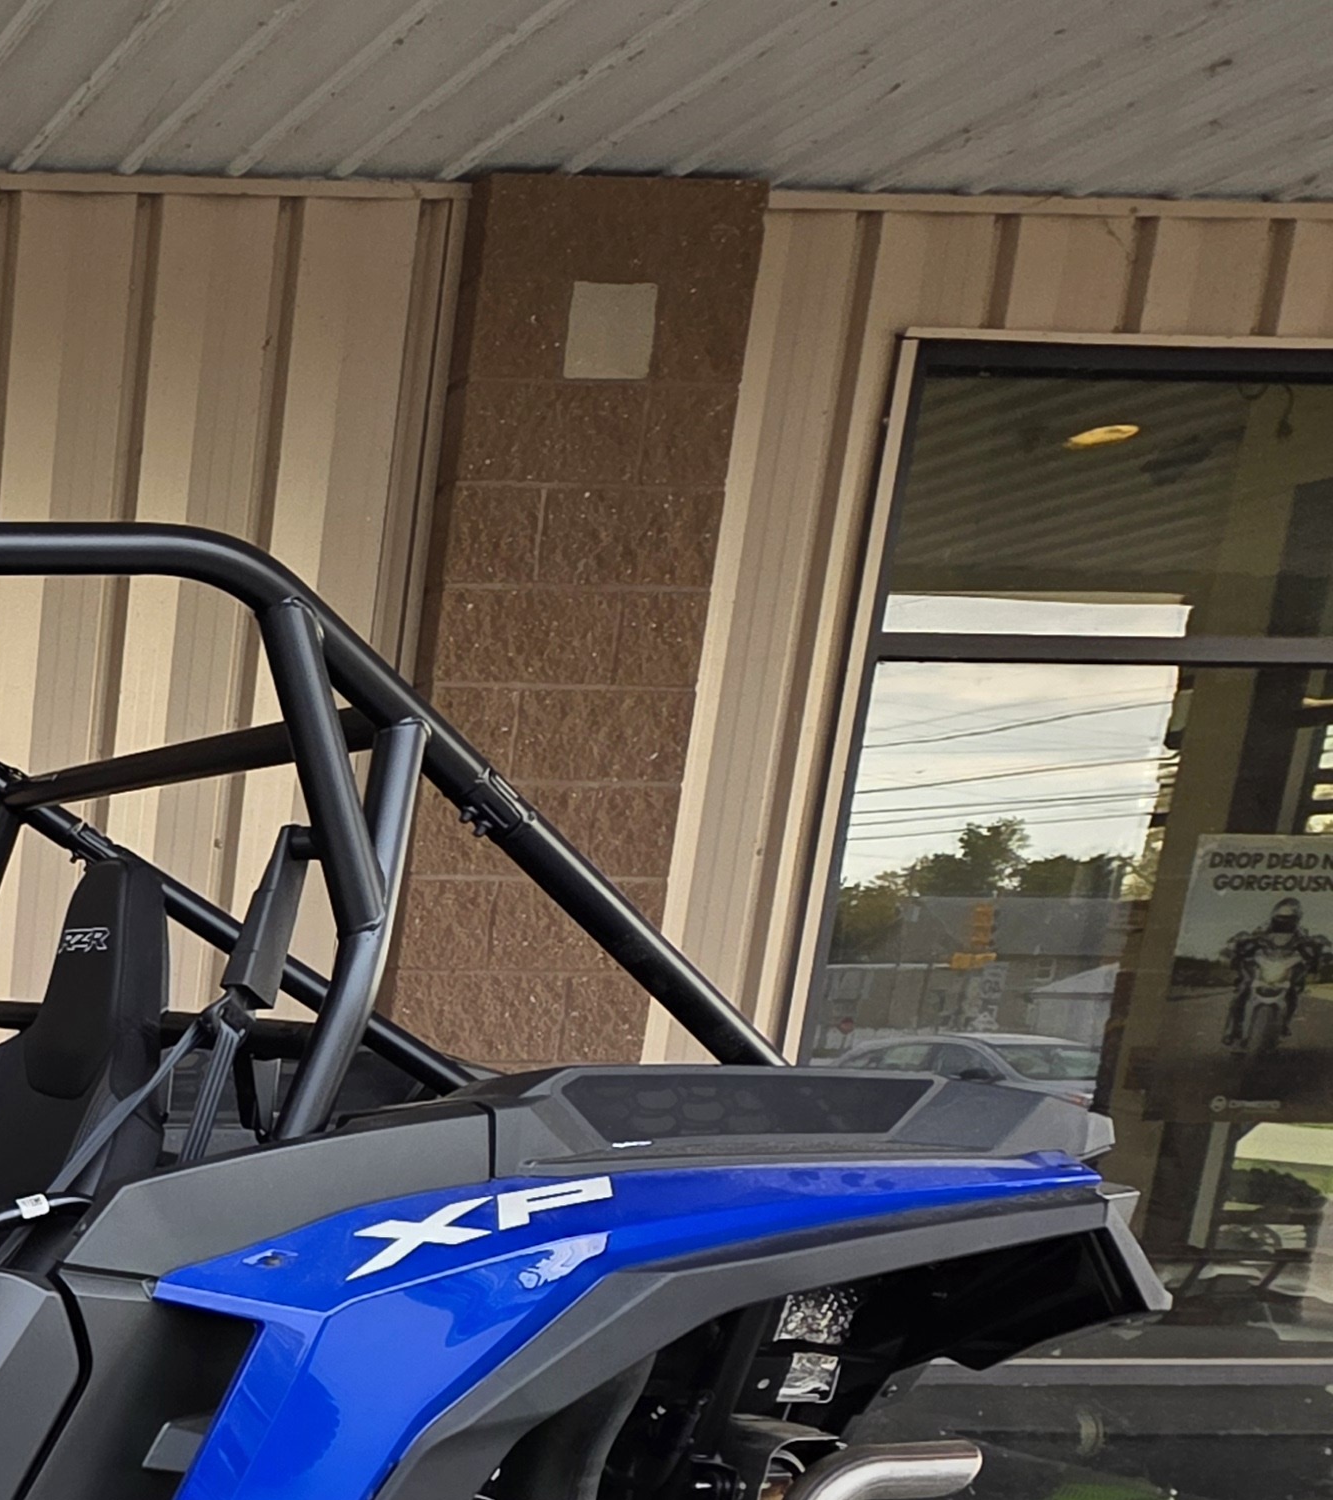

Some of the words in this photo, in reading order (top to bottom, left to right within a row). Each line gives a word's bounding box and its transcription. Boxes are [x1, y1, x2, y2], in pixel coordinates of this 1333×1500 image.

[1208, 851, 1264, 869] DROP
[1266, 852, 1320, 870] DEAD
[58, 926, 111, 954] RZR
[346, 1175, 614, 1281] XP
